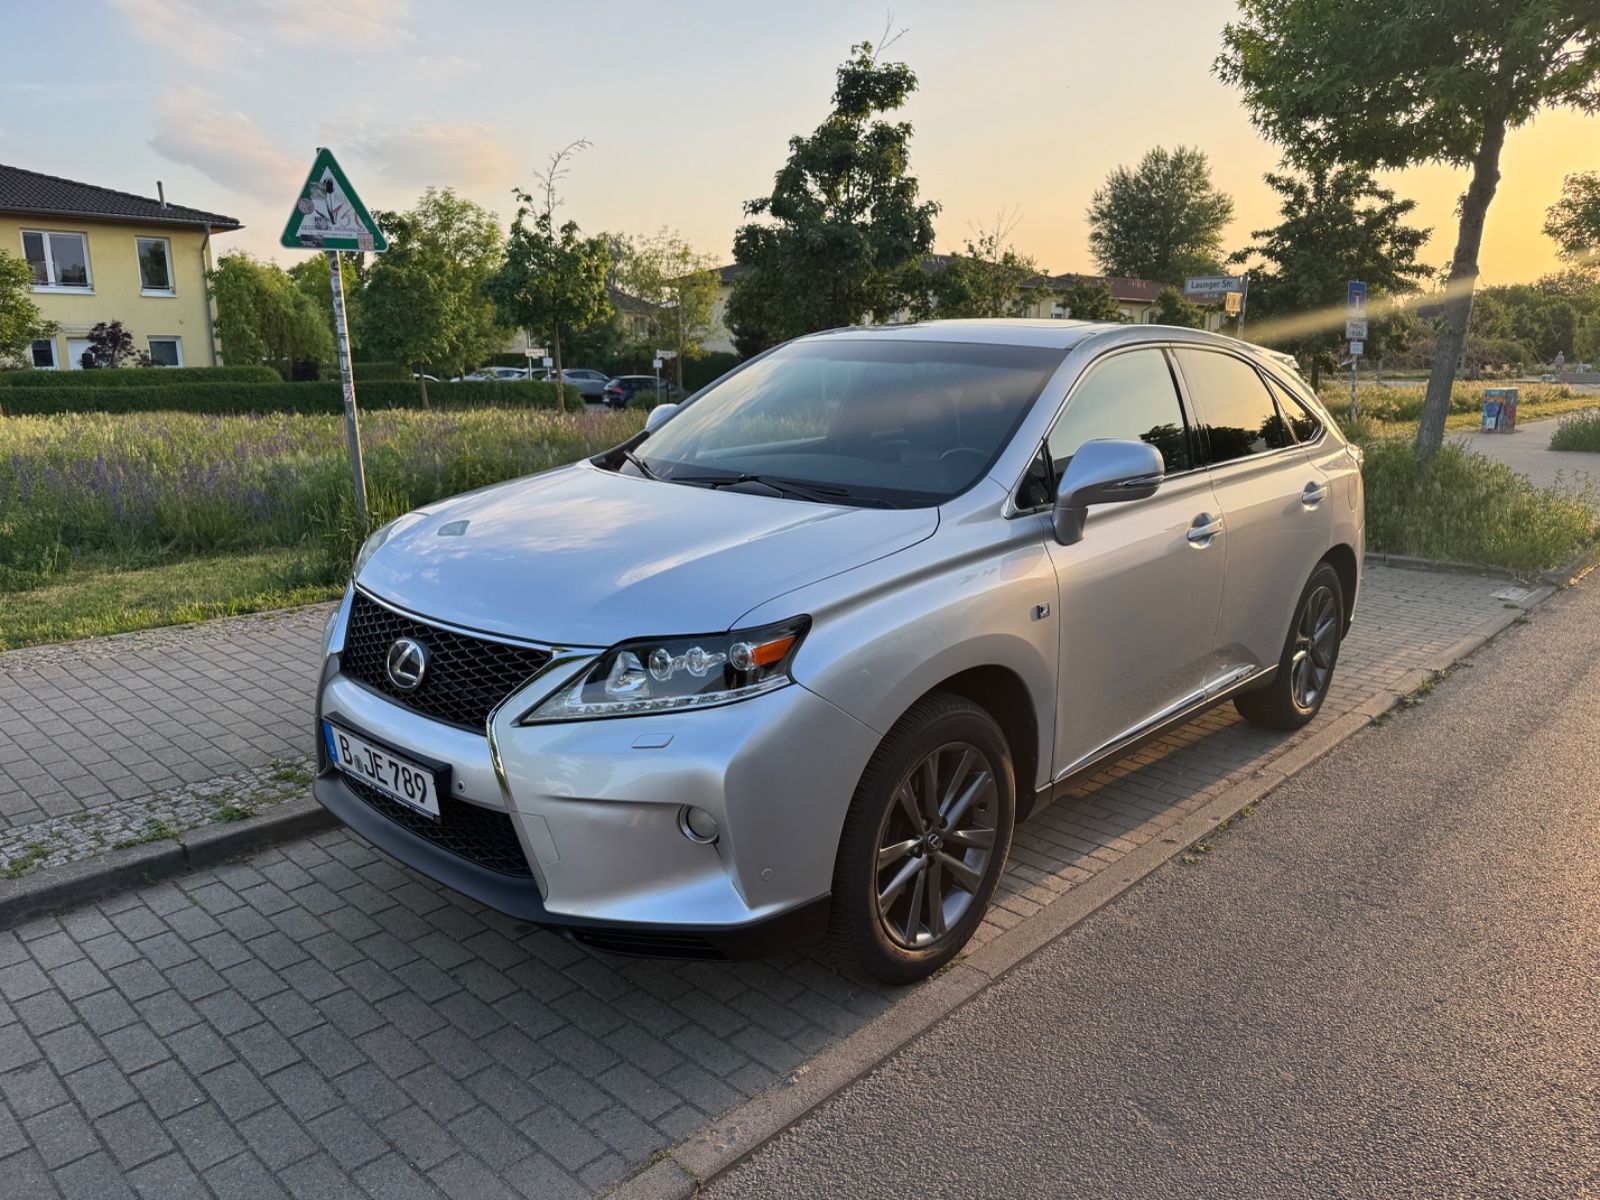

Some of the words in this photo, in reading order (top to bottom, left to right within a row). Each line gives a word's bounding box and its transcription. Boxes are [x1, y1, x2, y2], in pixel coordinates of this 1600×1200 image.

[339, 734, 353, 766] B
[363, 746, 389, 786] JE
[388, 759, 428, 804] 789
